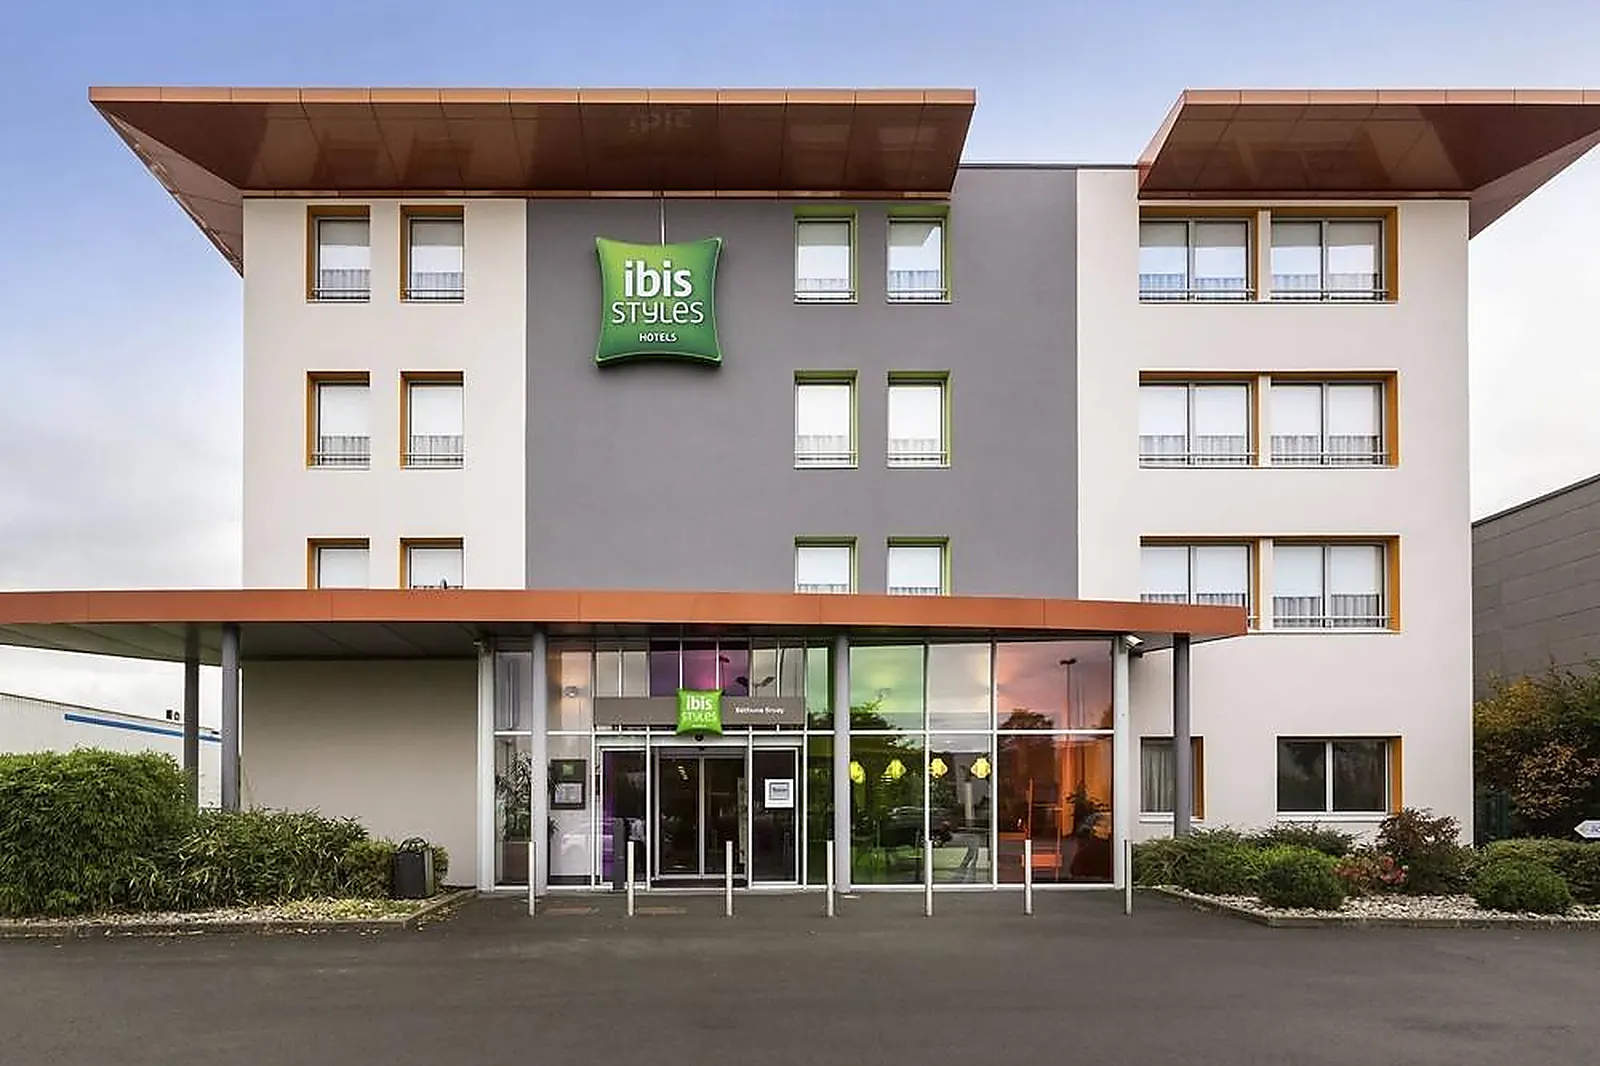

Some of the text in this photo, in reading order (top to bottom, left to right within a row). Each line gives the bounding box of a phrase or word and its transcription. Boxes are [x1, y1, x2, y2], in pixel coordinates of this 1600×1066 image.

[625, 260, 692, 297] ibis
[639, 332, 677, 342] HOTELS
[686, 695, 713, 710] ibis
